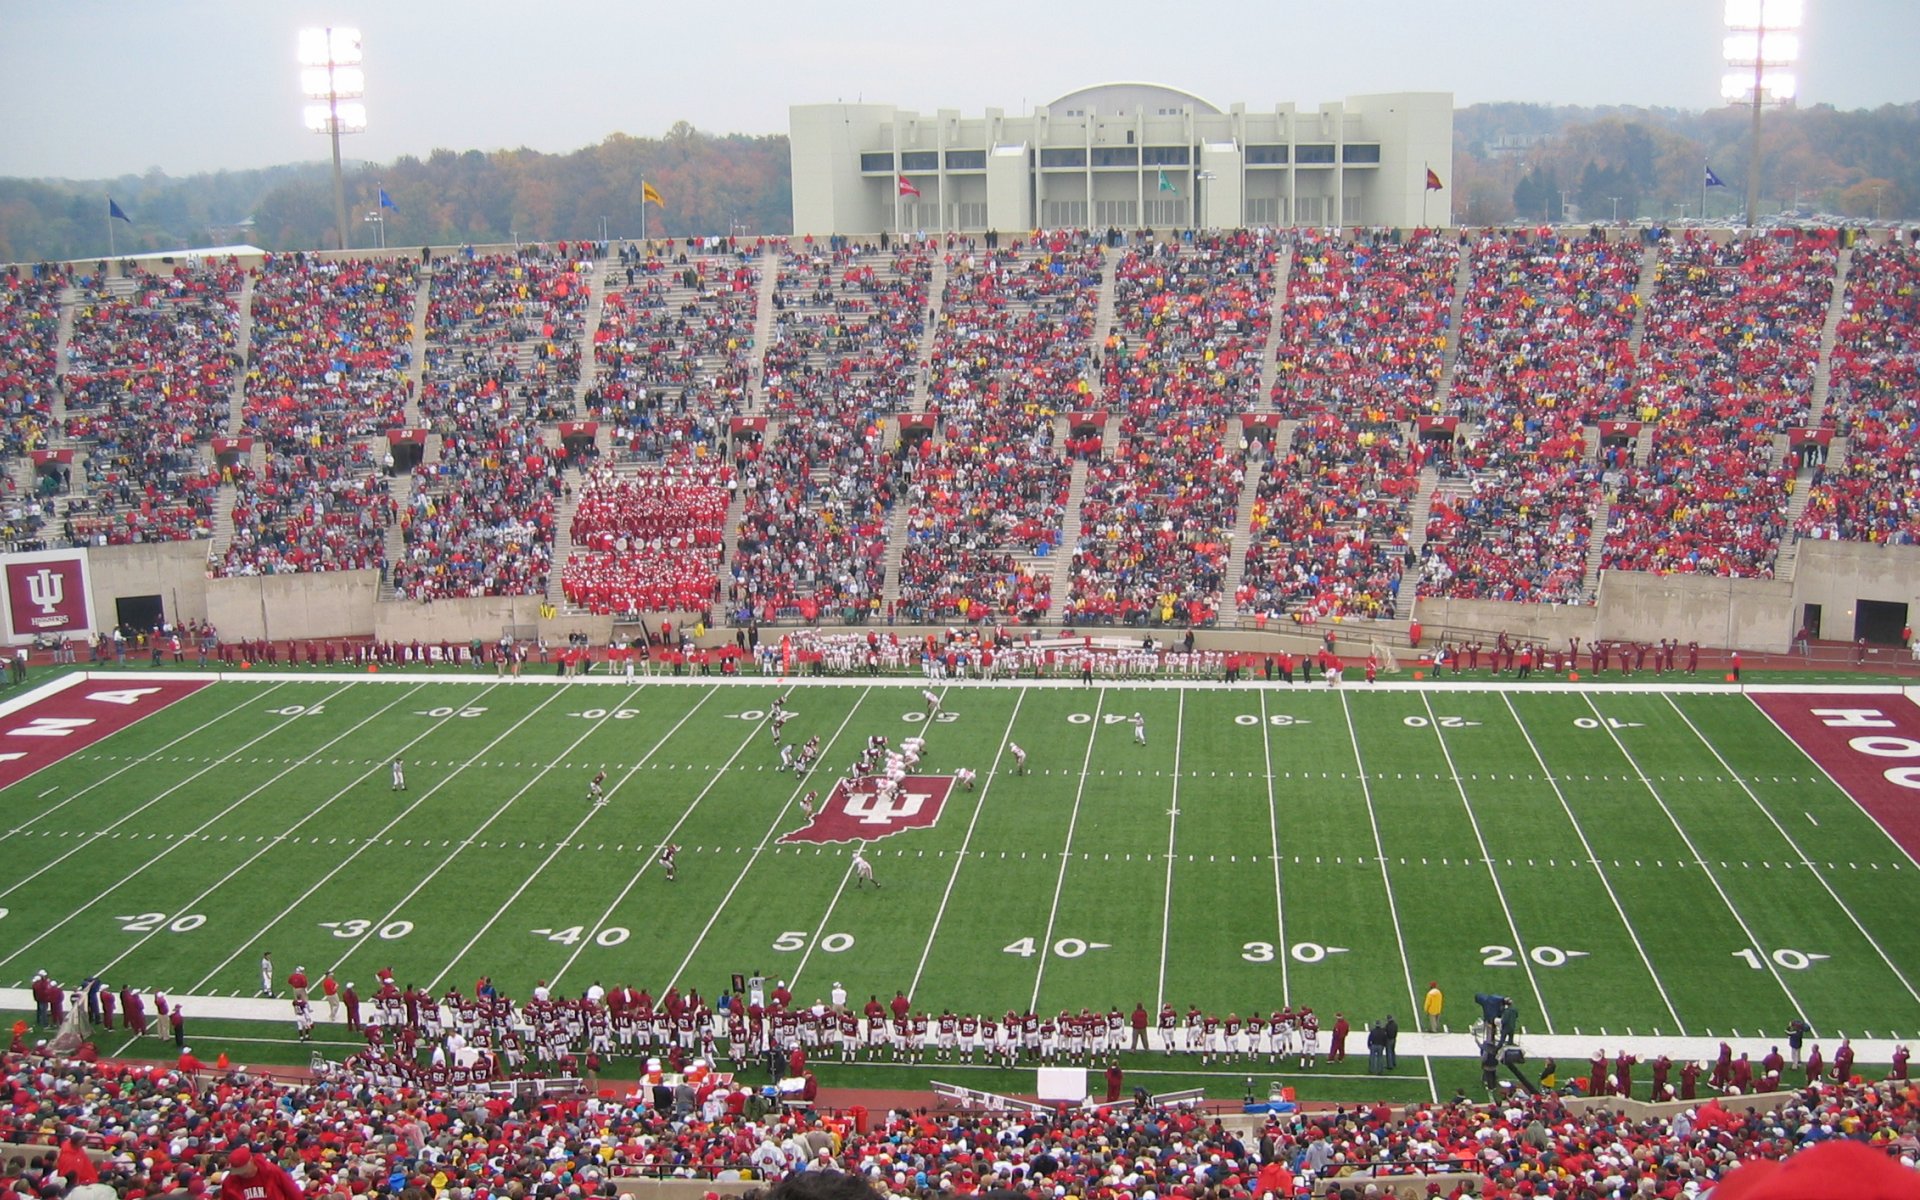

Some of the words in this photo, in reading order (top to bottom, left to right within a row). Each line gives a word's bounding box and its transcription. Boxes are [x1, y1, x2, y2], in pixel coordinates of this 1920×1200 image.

[1081, 413, 1094, 421] 27
[1431, 417, 1444, 425] 29
[572, 423, 585, 431] 24
[1613, 422, 1628, 431] 30
[1804, 429, 1818, 439] 31
[400, 431, 413, 439] 23
[226, 439, 238, 447] 22
[46, 451, 58, 459] 21
[121, 912, 207, 933] 20
[332, 918, 414, 939] 30
[548, 925, 631, 946] 40
[771, 931, 855, 953] 50
[1003, 937, 1087, 959] 40
[1241, 941, 1326, 963] 30
[1479, 945, 1567, 967] 20
[1731, 948, 1810, 970] 10
